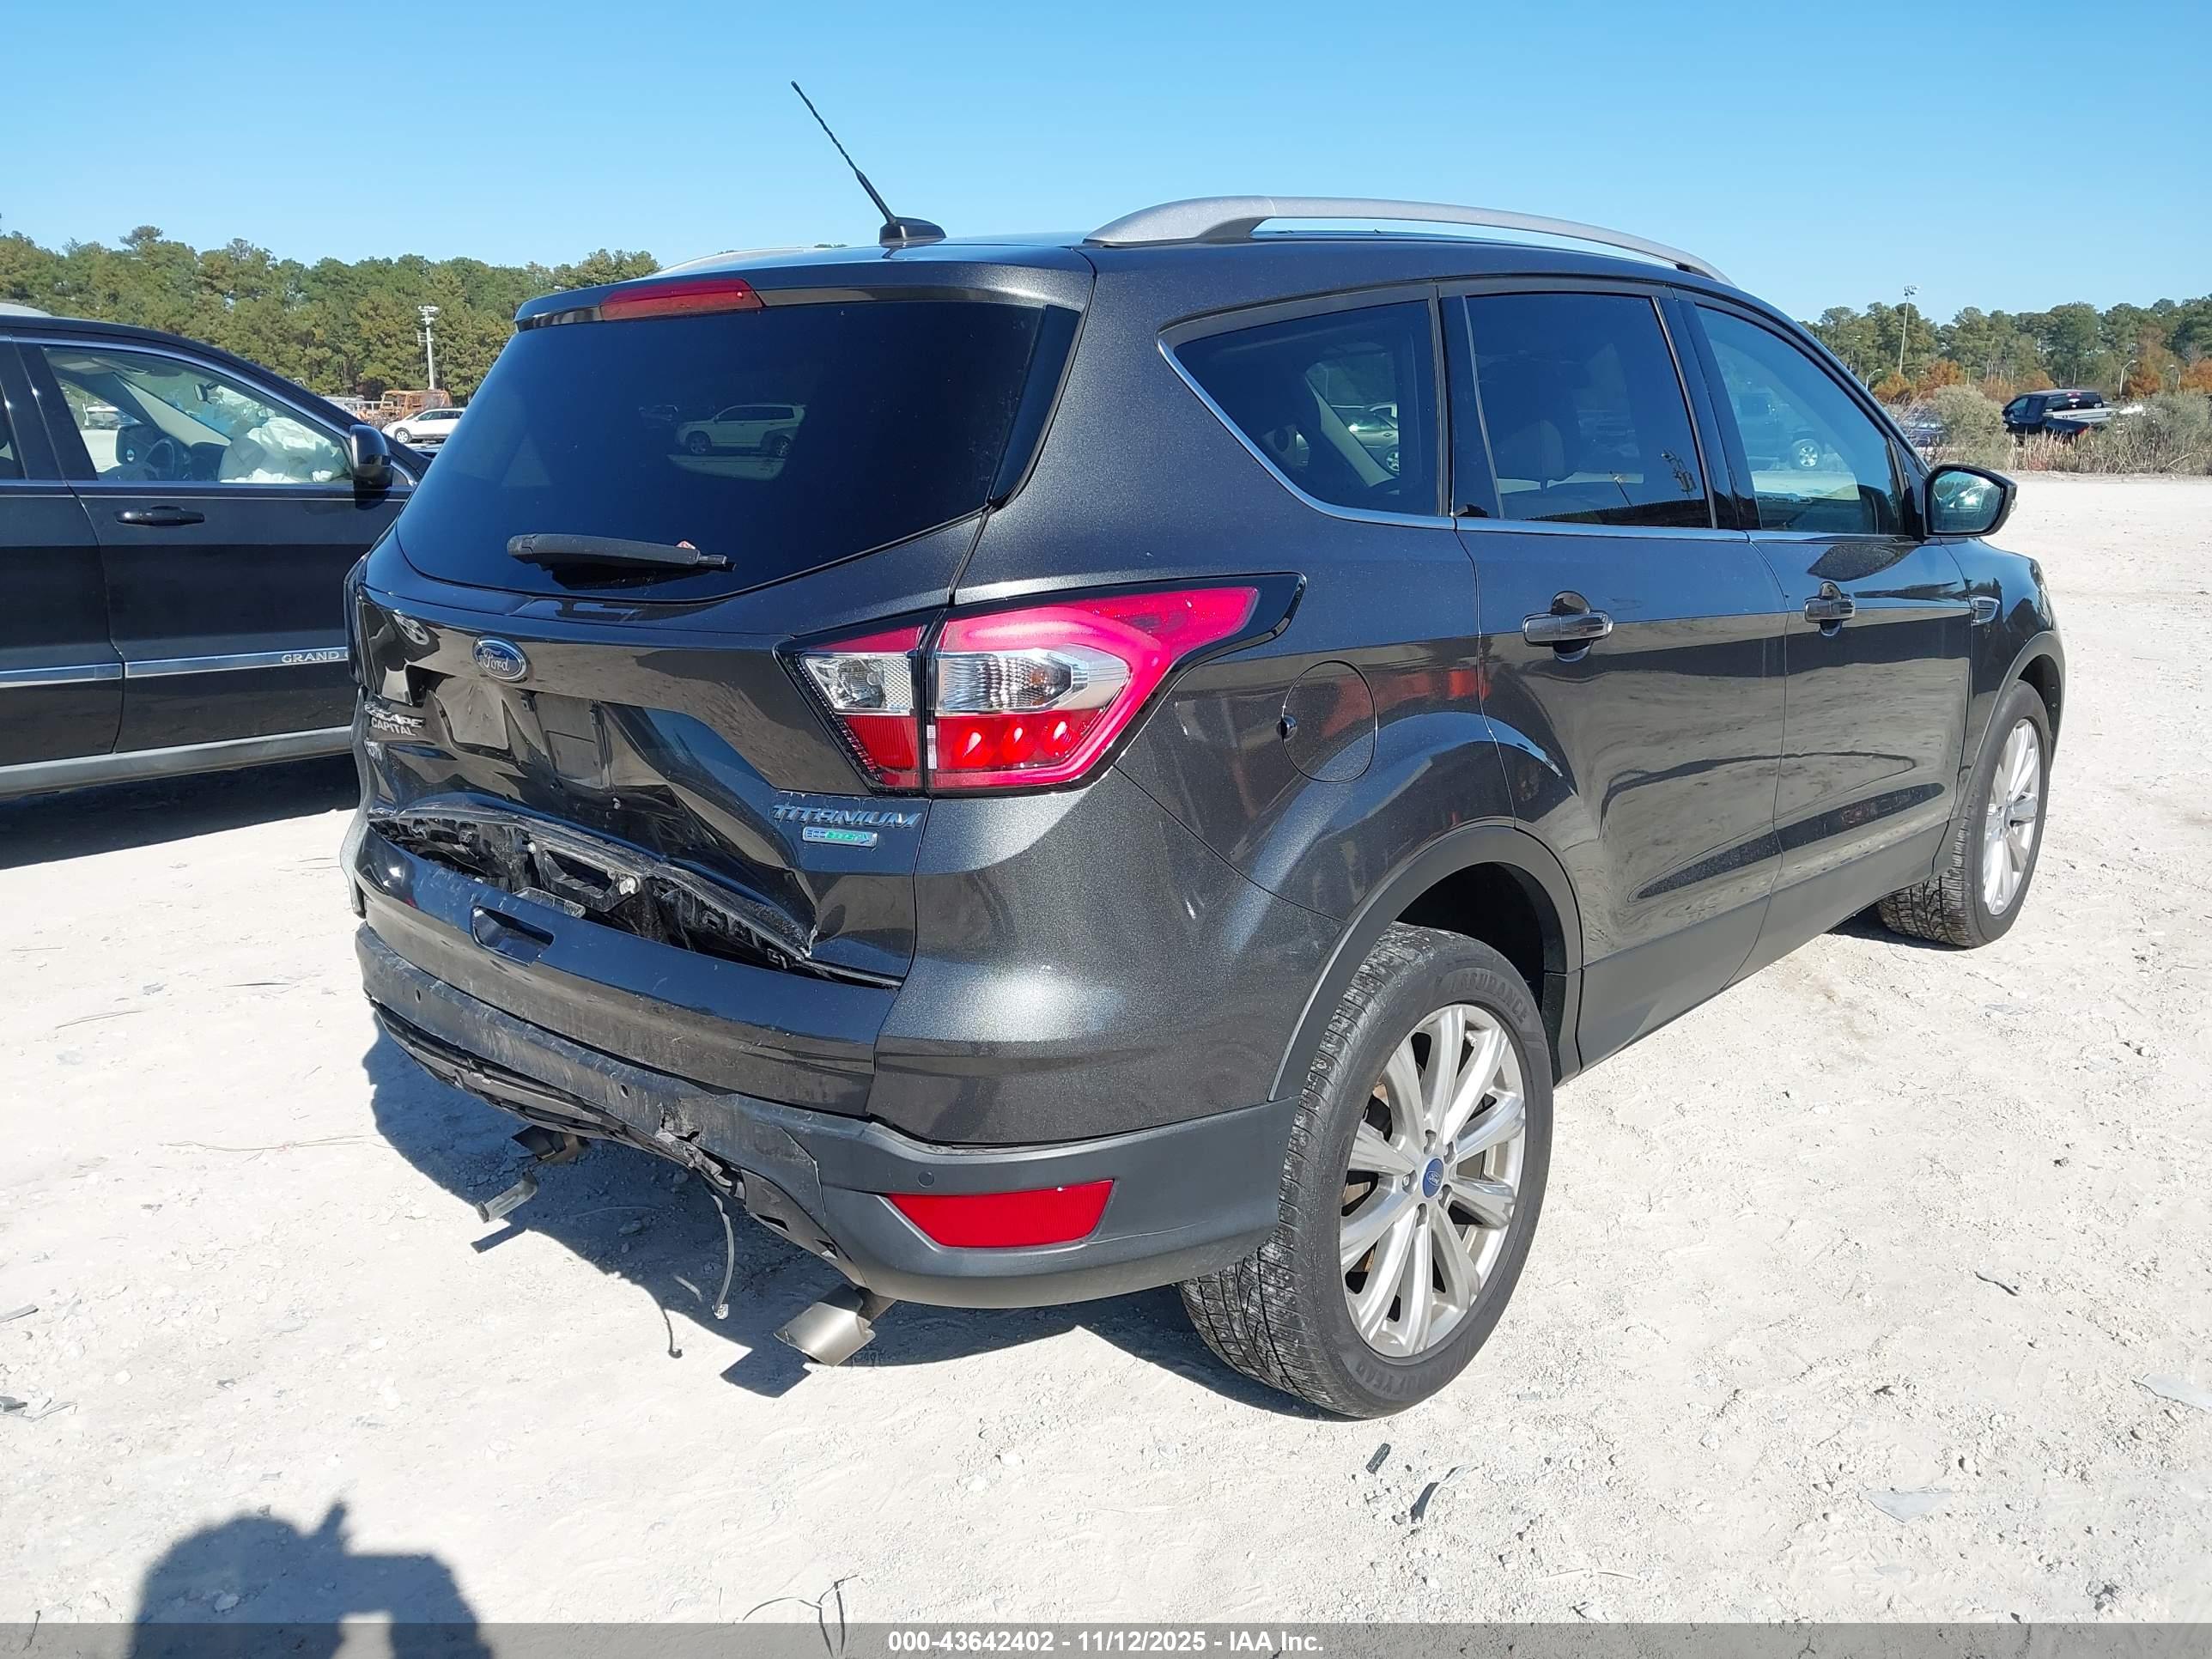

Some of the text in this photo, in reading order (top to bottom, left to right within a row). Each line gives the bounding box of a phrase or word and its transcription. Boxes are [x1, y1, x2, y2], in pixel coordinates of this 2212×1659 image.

[281, 651, 340, 664] GRAND
[483, 647, 510, 672] Ford
[371, 717, 416, 736] CAPITAL
[772, 804, 921, 829] TITANIUM
